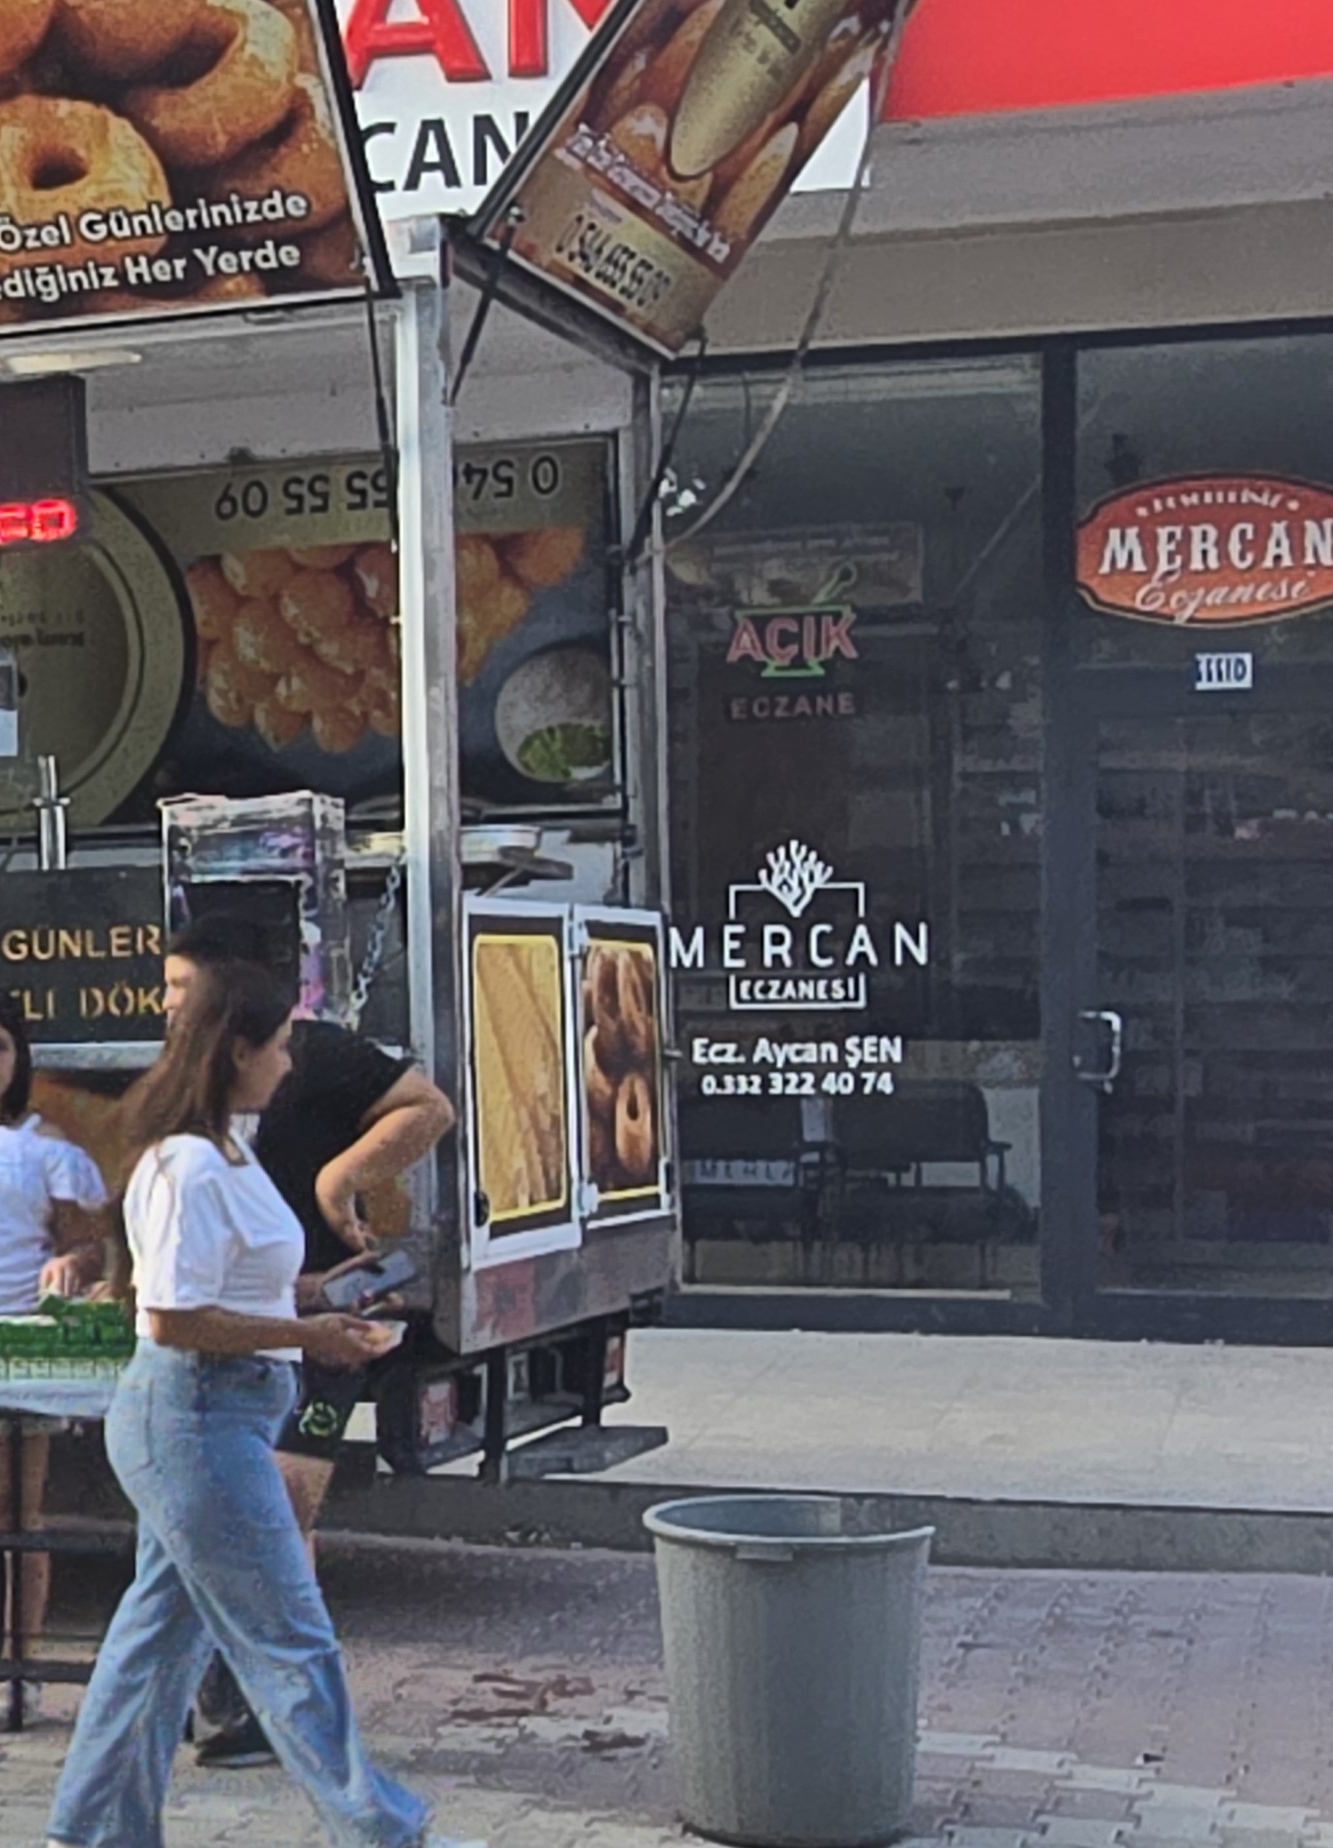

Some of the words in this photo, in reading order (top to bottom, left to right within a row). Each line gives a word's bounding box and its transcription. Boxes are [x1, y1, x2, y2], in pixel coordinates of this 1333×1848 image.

[78, 189, 308, 243] Günlerinizde
[126, 254, 187, 286] Her
[194, 240, 301, 277] Yerde
[282, 474, 331, 516] 55
[454, 459, 515, 500] 54
[531, 455, 560, 496] 0
[214, 480, 269, 521] 09
[1098, 516, 1333, 575] MERCAN
[726, 613, 859, 666] AÇIK
[730, 692, 856, 719] ECZANE
[668, 921, 929, 968] MERCAN
[752, 1037, 838, 1068] Aycan
[844, 1036, 902, 1068] ŞEN
[767, 1072, 816, 1095] 322
[821, 1072, 855, 1095] 40
[861, 1072, 894, 1095] 74
